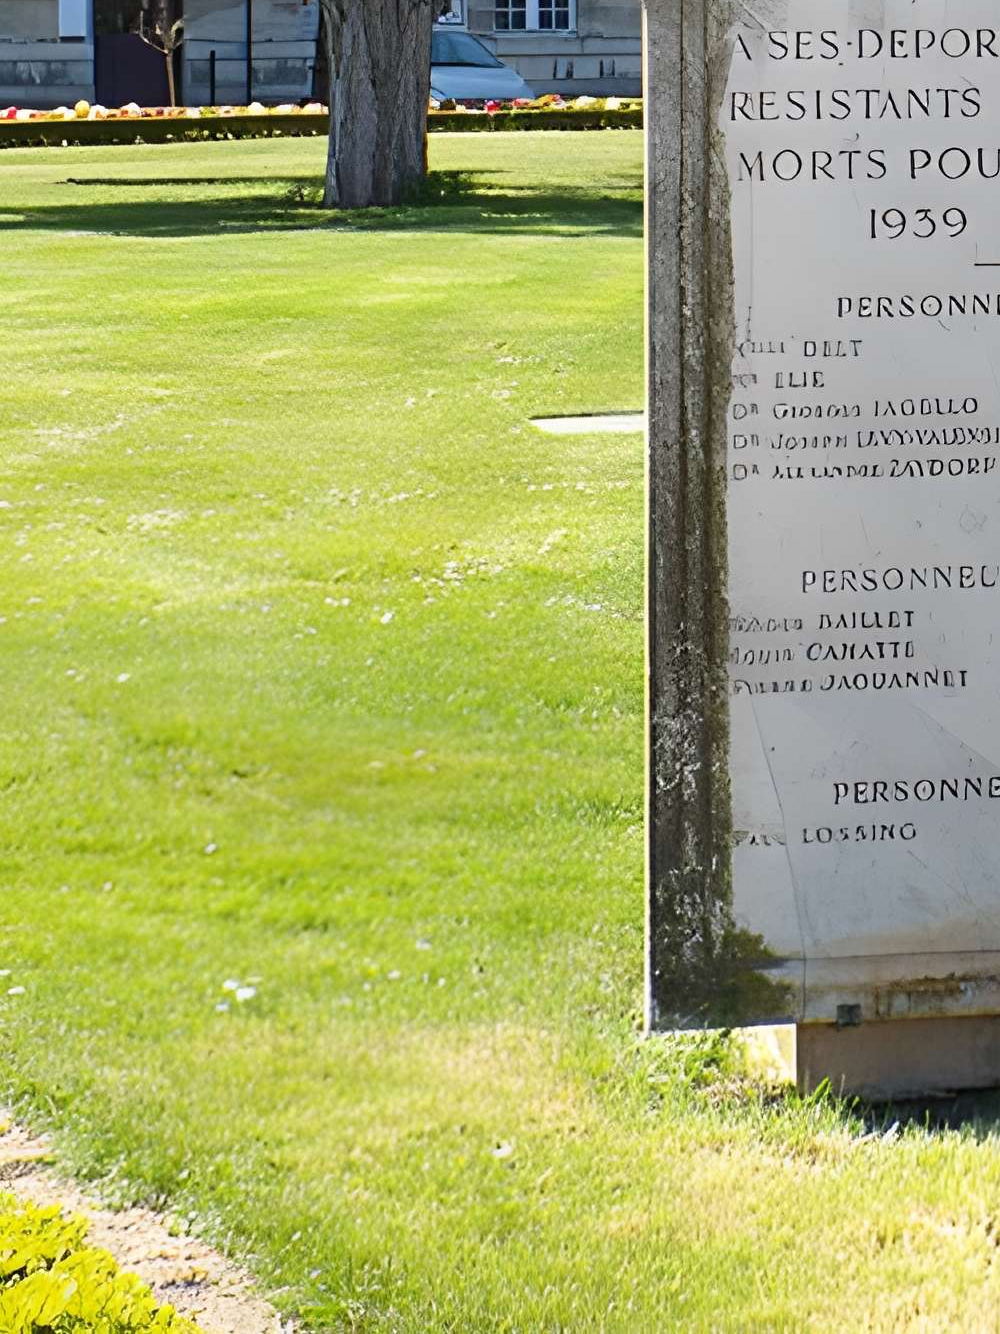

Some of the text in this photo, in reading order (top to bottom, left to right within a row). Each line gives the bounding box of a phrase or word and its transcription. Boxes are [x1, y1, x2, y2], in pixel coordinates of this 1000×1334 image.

[765, 27, 842, 61] SES
[728, 86, 983, 122] RESISTANTS
[737, 147, 887, 183] MORTS
[869, 207, 968, 241] 1939
